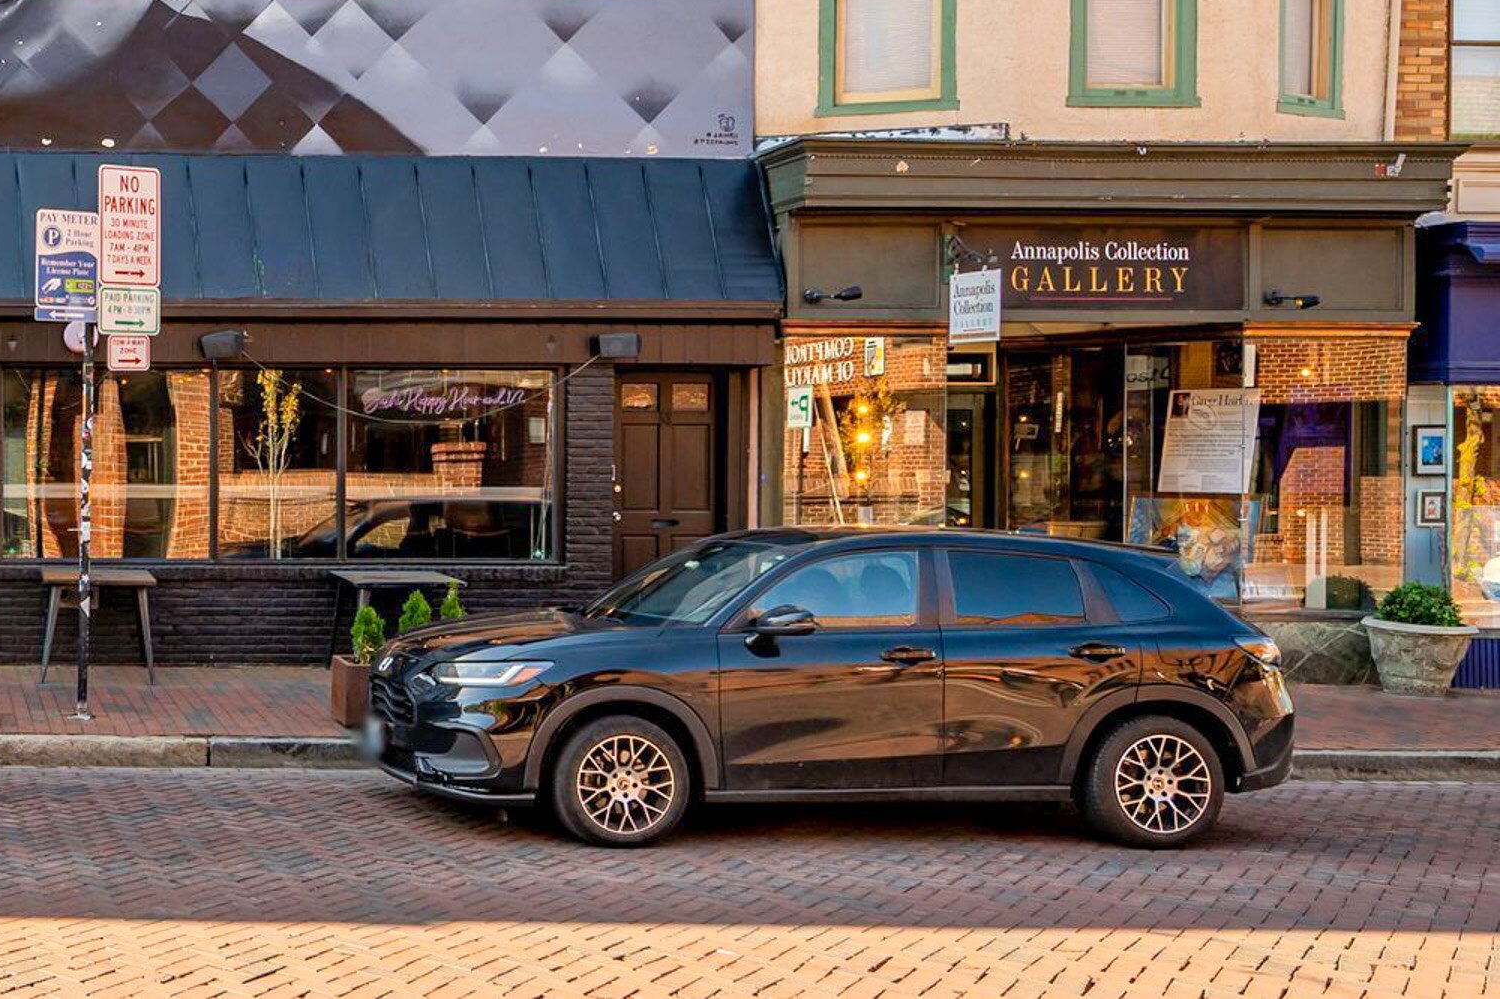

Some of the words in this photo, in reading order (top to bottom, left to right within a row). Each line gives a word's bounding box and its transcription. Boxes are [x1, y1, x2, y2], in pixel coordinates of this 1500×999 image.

[120, 175, 140, 193] NO
[104, 195, 156, 216] PARKING
[40, 212, 58, 222] PAY
[62, 213, 98, 225] METER
[110, 218, 120, 227] 30
[123, 219, 148, 229] MINUTE
[48, 228, 60, 246] P
[104, 230, 135, 241] LOADING
[137, 232, 155, 242] ZONE
[136, 255, 152, 265] WEEK
[1011, 240, 1101, 265] Annapolis
[1104, 241, 1191, 262] Collection
[1011, 265, 1189, 293] GALLERY
[123, 293, 155, 303] PARKING
[953, 281, 996, 300] Annapolis
[953, 299, 994, 315] Collection
